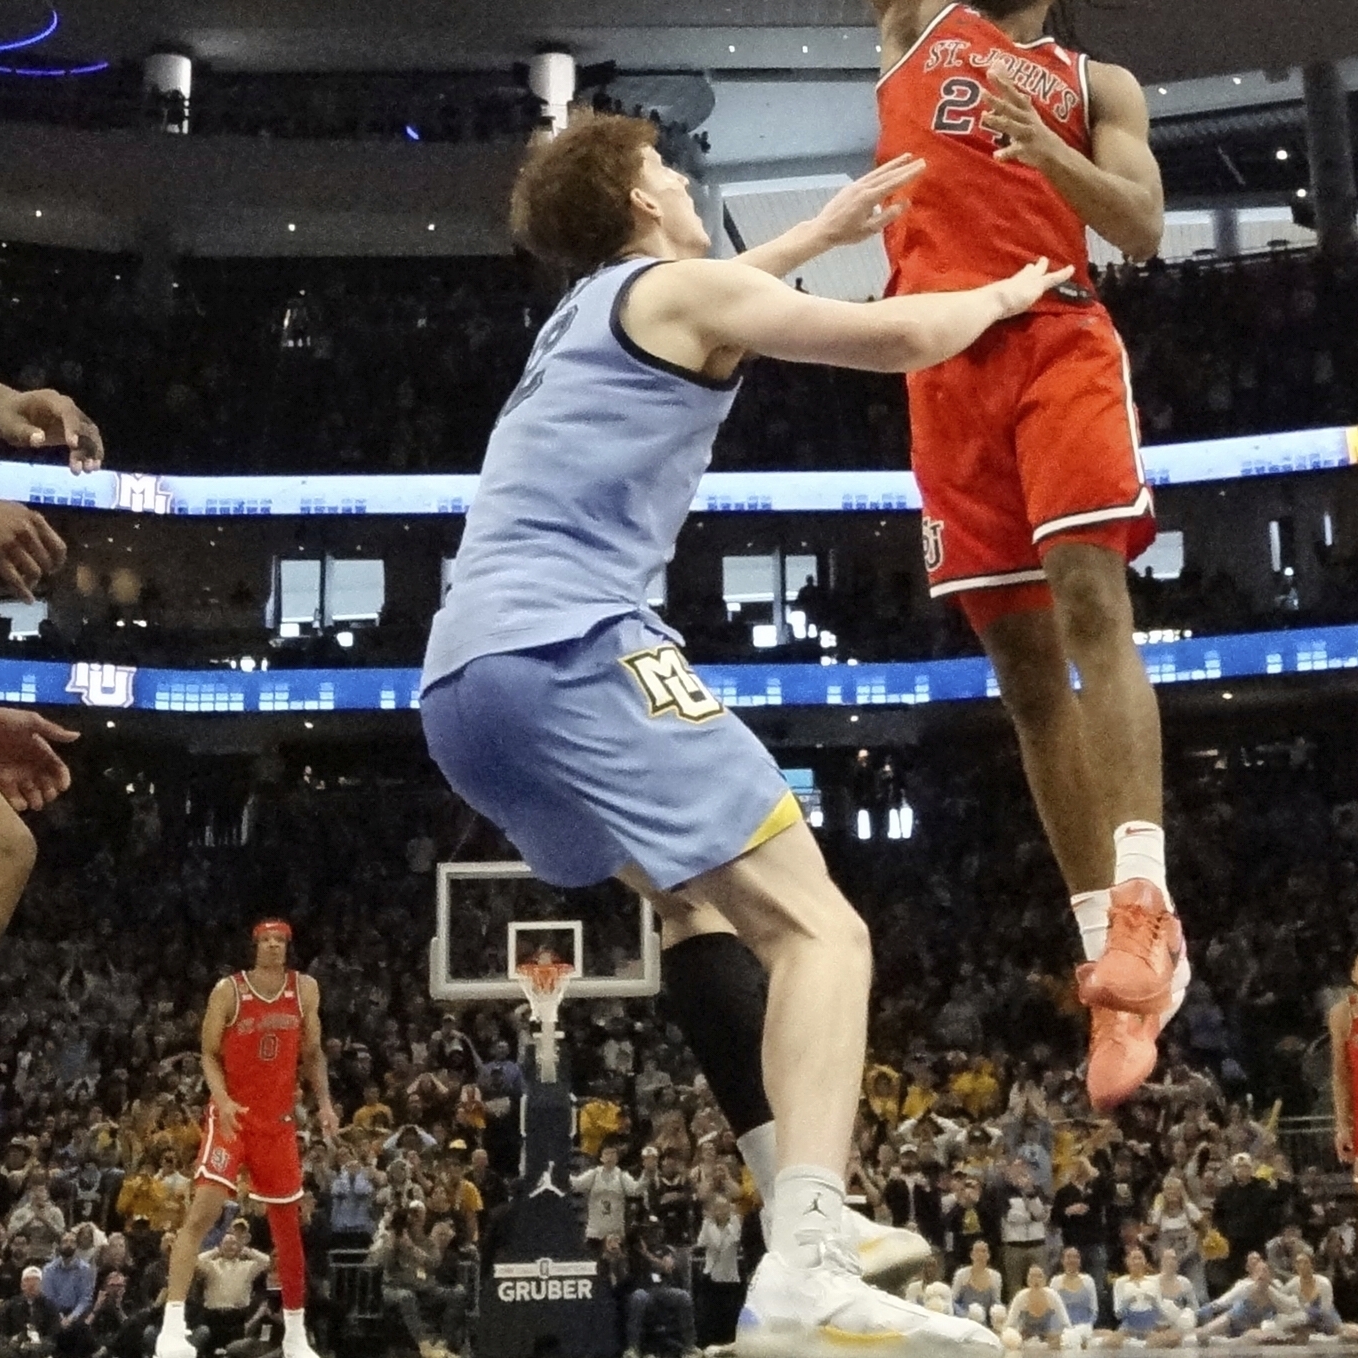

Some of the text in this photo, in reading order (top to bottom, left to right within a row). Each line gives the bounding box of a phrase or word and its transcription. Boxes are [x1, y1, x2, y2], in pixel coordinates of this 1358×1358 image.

[619, 645, 727, 724] MU
[259, 1033, 279, 1062] 0
[498, 1279, 593, 1302] GRUBER
